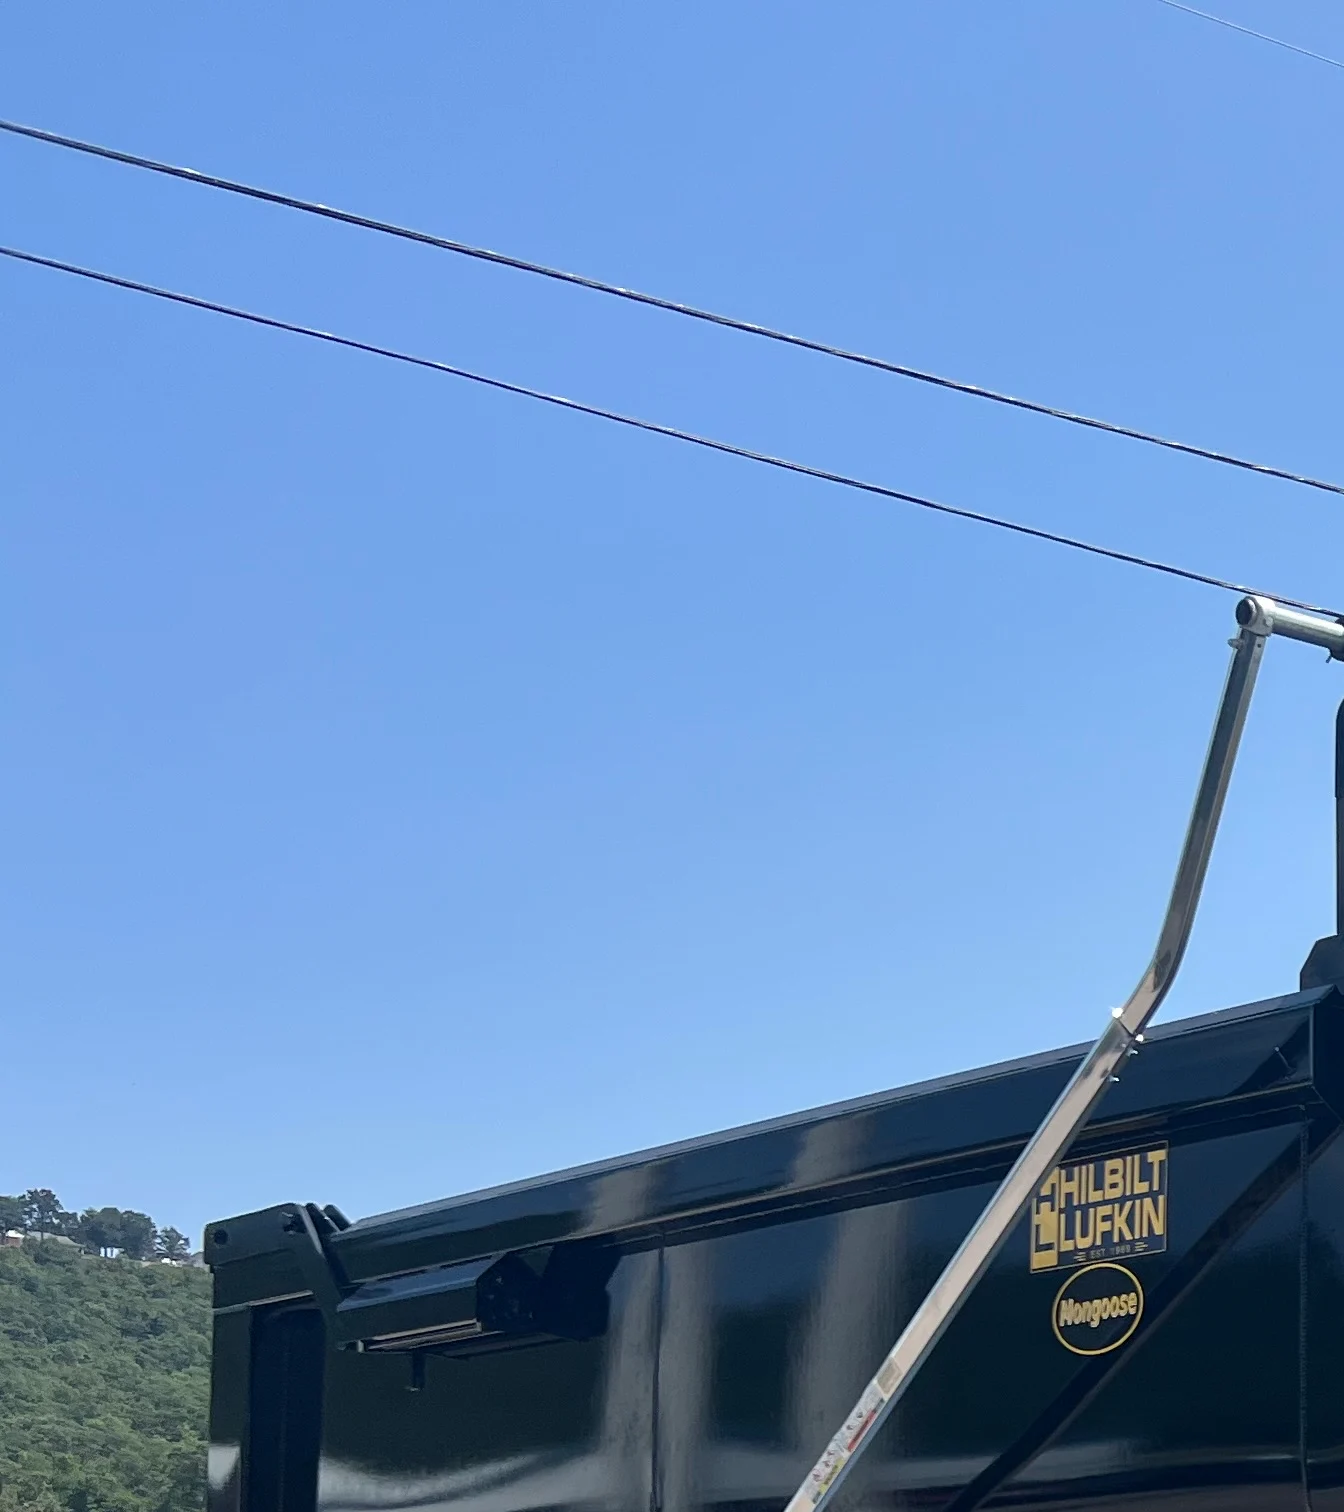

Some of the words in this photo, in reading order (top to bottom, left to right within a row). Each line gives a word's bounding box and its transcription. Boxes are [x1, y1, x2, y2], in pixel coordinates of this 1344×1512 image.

[1060, 1150, 1166, 1209] HILBILT
[1060, 1195, 1166, 1252] LUFKIN
[1059, 1291, 1138, 1328] Mongoose
